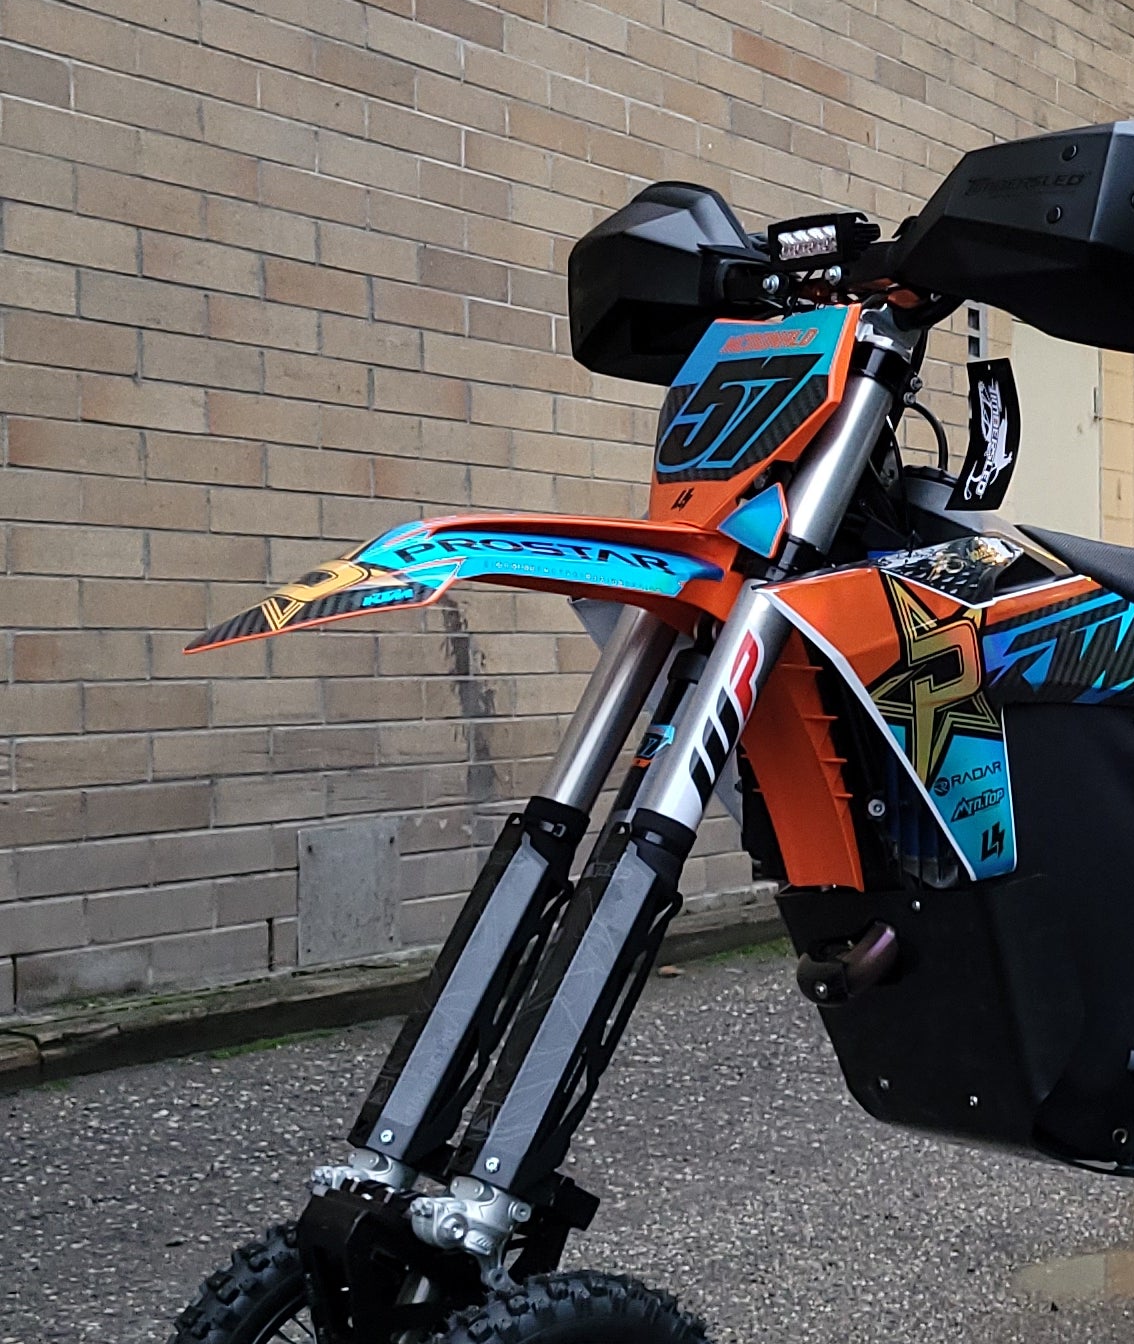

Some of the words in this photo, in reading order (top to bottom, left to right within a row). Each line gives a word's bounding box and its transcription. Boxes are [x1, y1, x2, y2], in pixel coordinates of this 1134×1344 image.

[655, 353, 825, 473] 57
[393, 537, 677, 576] PROSTAR
[951, 760, 1003, 788] RADAR
